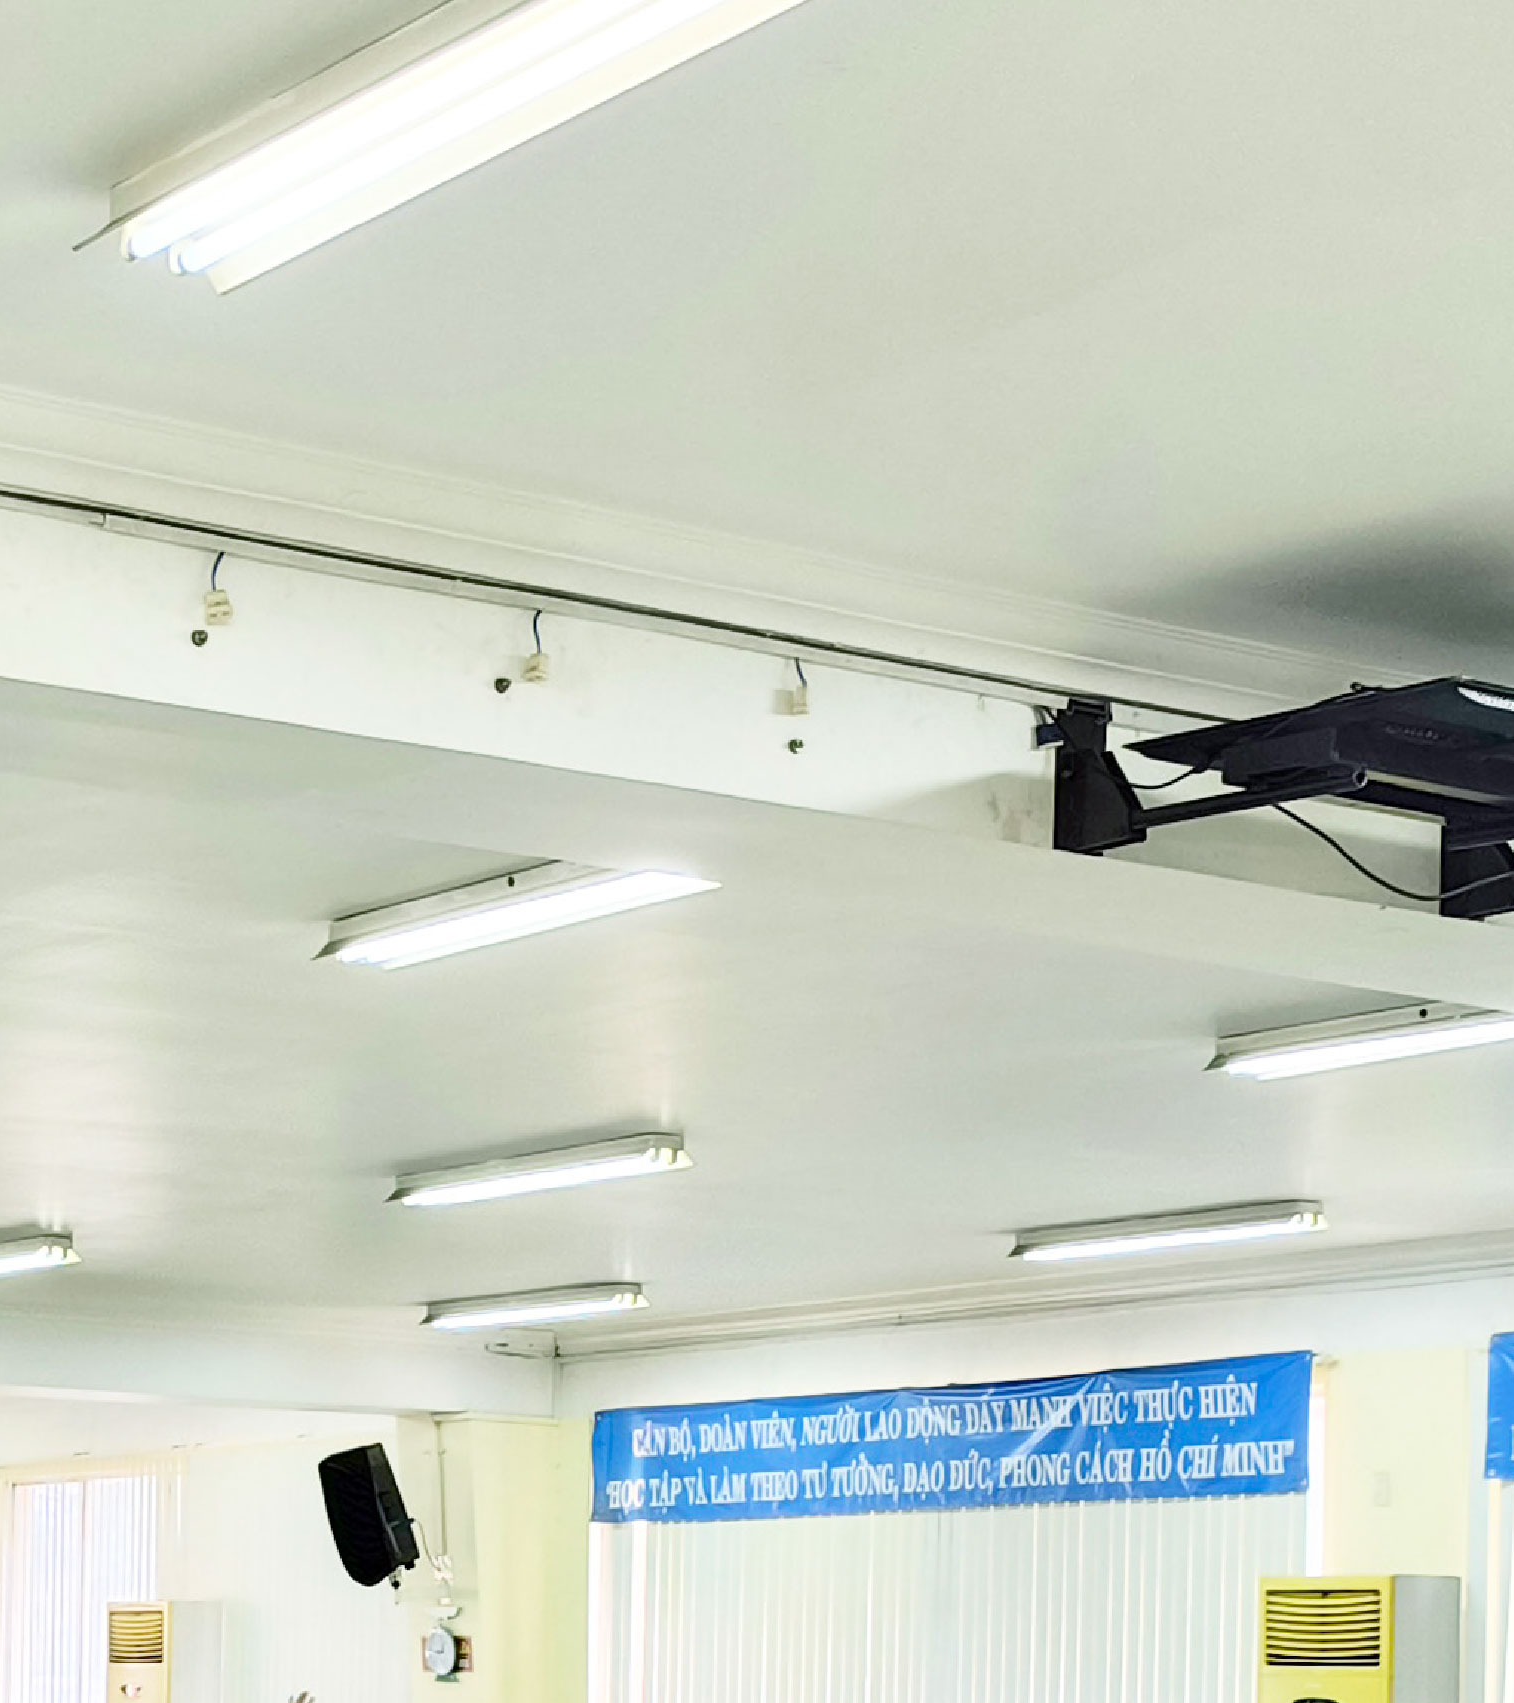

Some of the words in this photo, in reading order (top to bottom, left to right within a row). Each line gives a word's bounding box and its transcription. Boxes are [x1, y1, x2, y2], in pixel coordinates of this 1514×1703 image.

[668, 1417, 696, 1462] BỘ,
[699, 1414, 747, 1454] ĐOÀN
[750, 1410, 796, 1452] VIÊN,
[799, 1405, 861, 1446] NGƯỜI
[864, 1408, 900, 1442] LAO
[905, 1396, 961, 1445] ĐỘNG
[1078, 1383, 1127, 1433] VIỆC
[1133, 1380, 1194, 1429] THỰC
[1199, 1374, 1257, 1426] HIỆN
[649, 1469, 682, 1514] TẬP
[683, 1467, 708, 1506] VÀ
[710, 1466, 747, 1504] LÀM
[750, 1470, 798, 1501] THEO
[801, 1460, 826, 1499] TƯ
[902, 1462, 945, 1500] ĐẠO
[948, 1448, 993, 1494] ĐỨC,
[999, 1452, 1070, 1489] PHONG
[1076, 1440, 1134, 1485] CÁCH
[1139, 1430, 1171, 1481] HỒ
[1177, 1434, 1219, 1479] CHÍ
